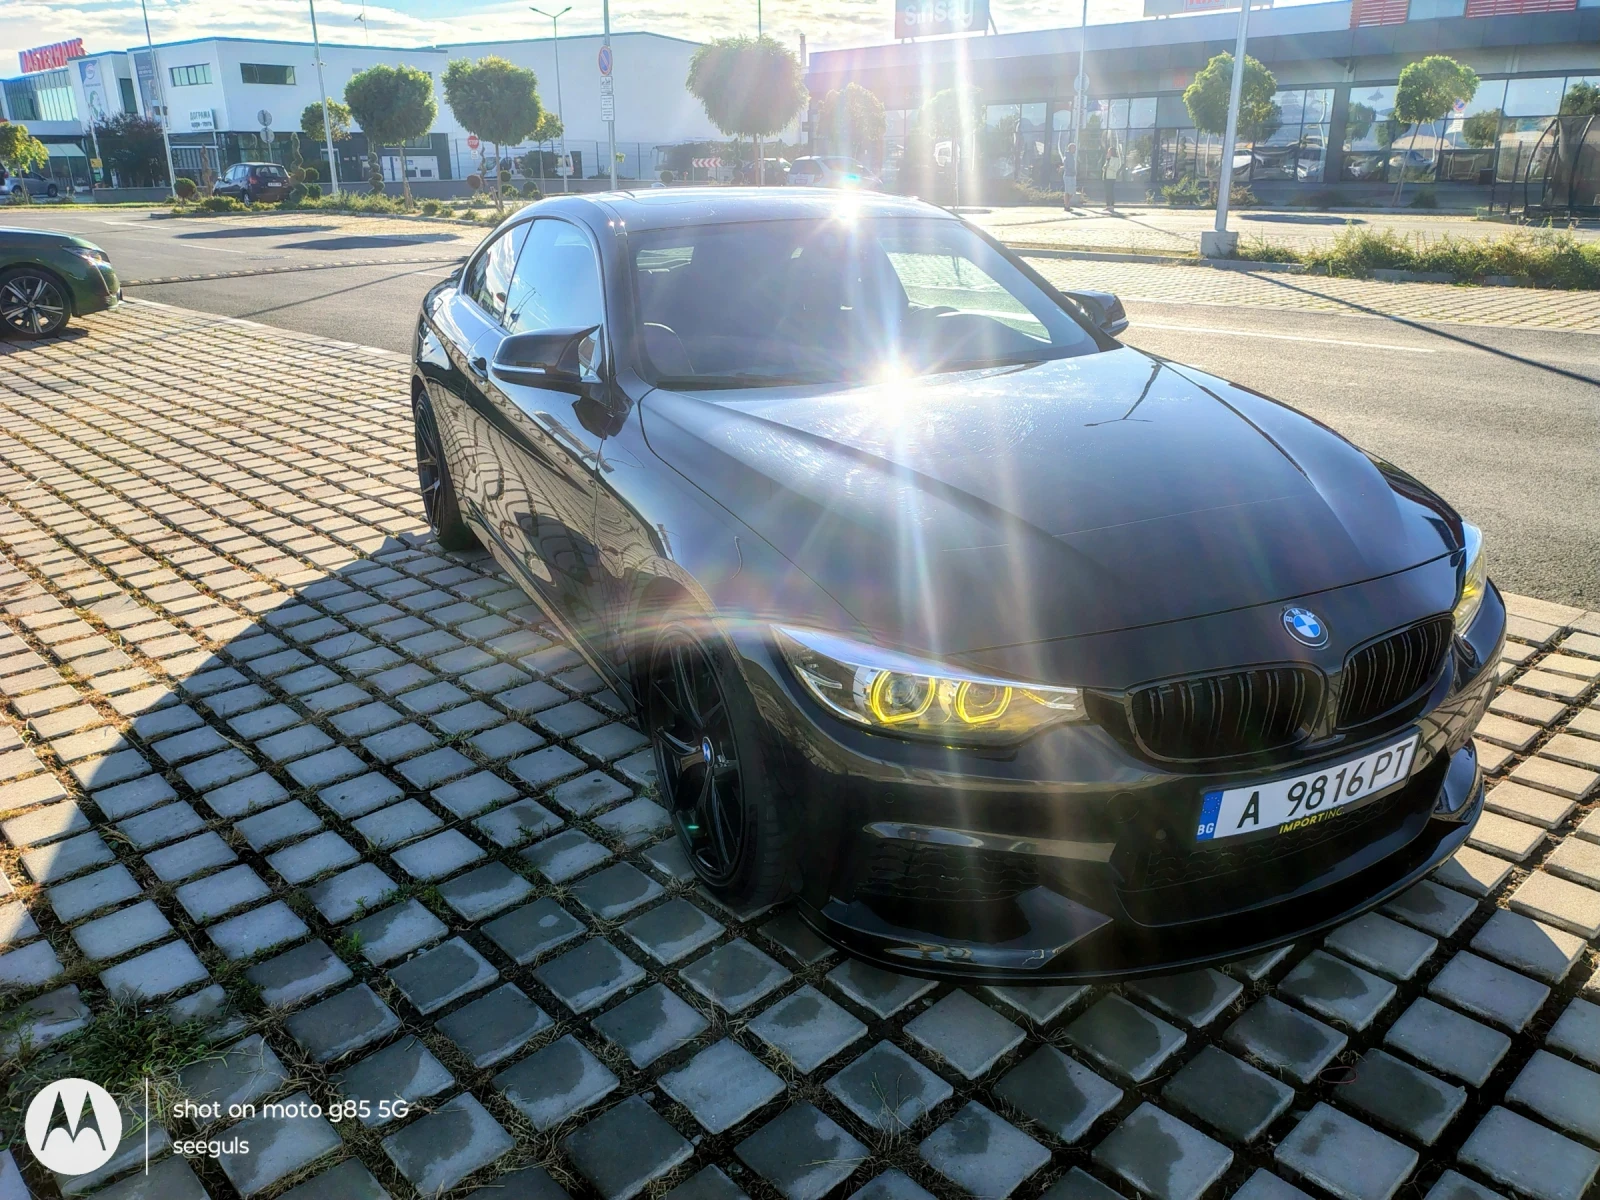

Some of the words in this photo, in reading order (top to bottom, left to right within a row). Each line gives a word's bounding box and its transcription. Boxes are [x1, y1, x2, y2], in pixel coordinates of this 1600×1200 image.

[904, 0, 973, 29] sinsay
[1285, 608, 1315, 623] BMW
[1236, 790, 1260, 829] A
[1197, 822, 1215, 836] BG
